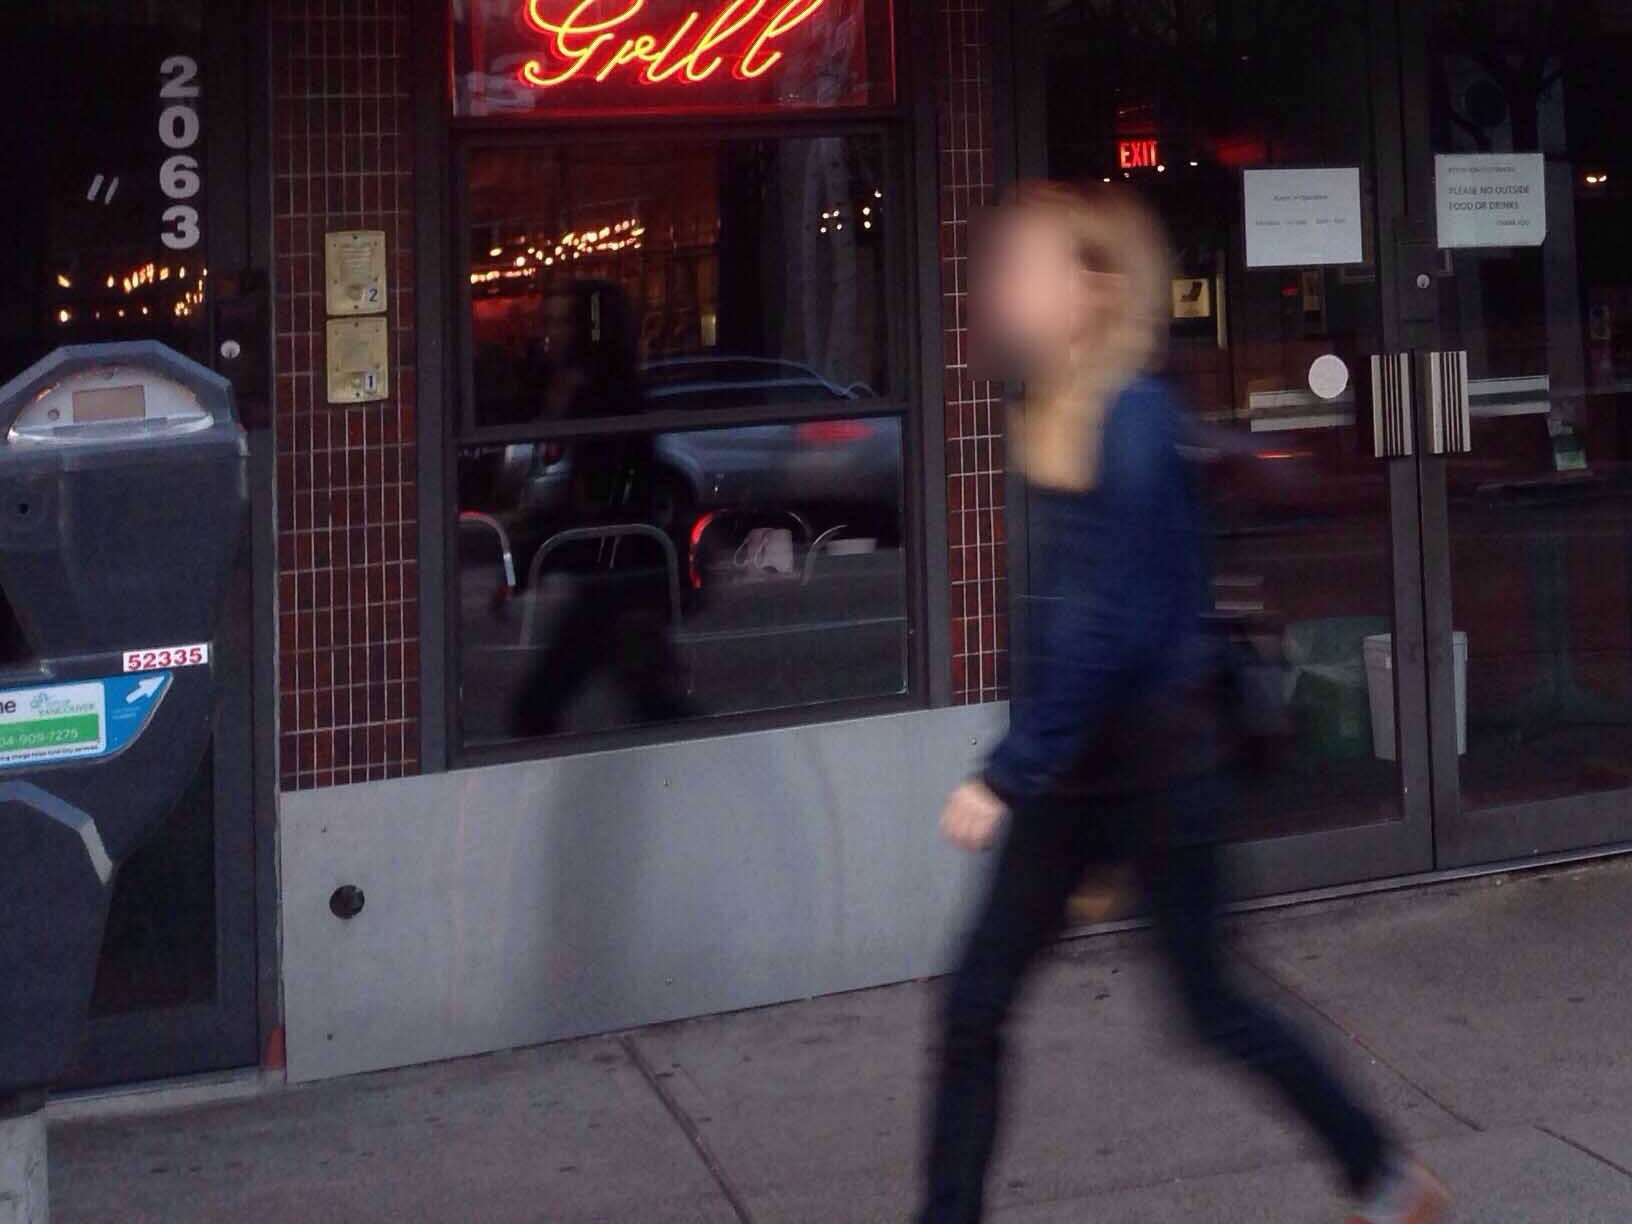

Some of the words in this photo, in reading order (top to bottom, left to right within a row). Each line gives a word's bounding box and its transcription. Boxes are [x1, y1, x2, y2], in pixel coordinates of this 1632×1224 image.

[158, 55, 200, 250] 2063
[1119, 140, 1157, 168] EXIT
[368, 288, 379, 303] 2
[128, 647, 203, 670] 52335
